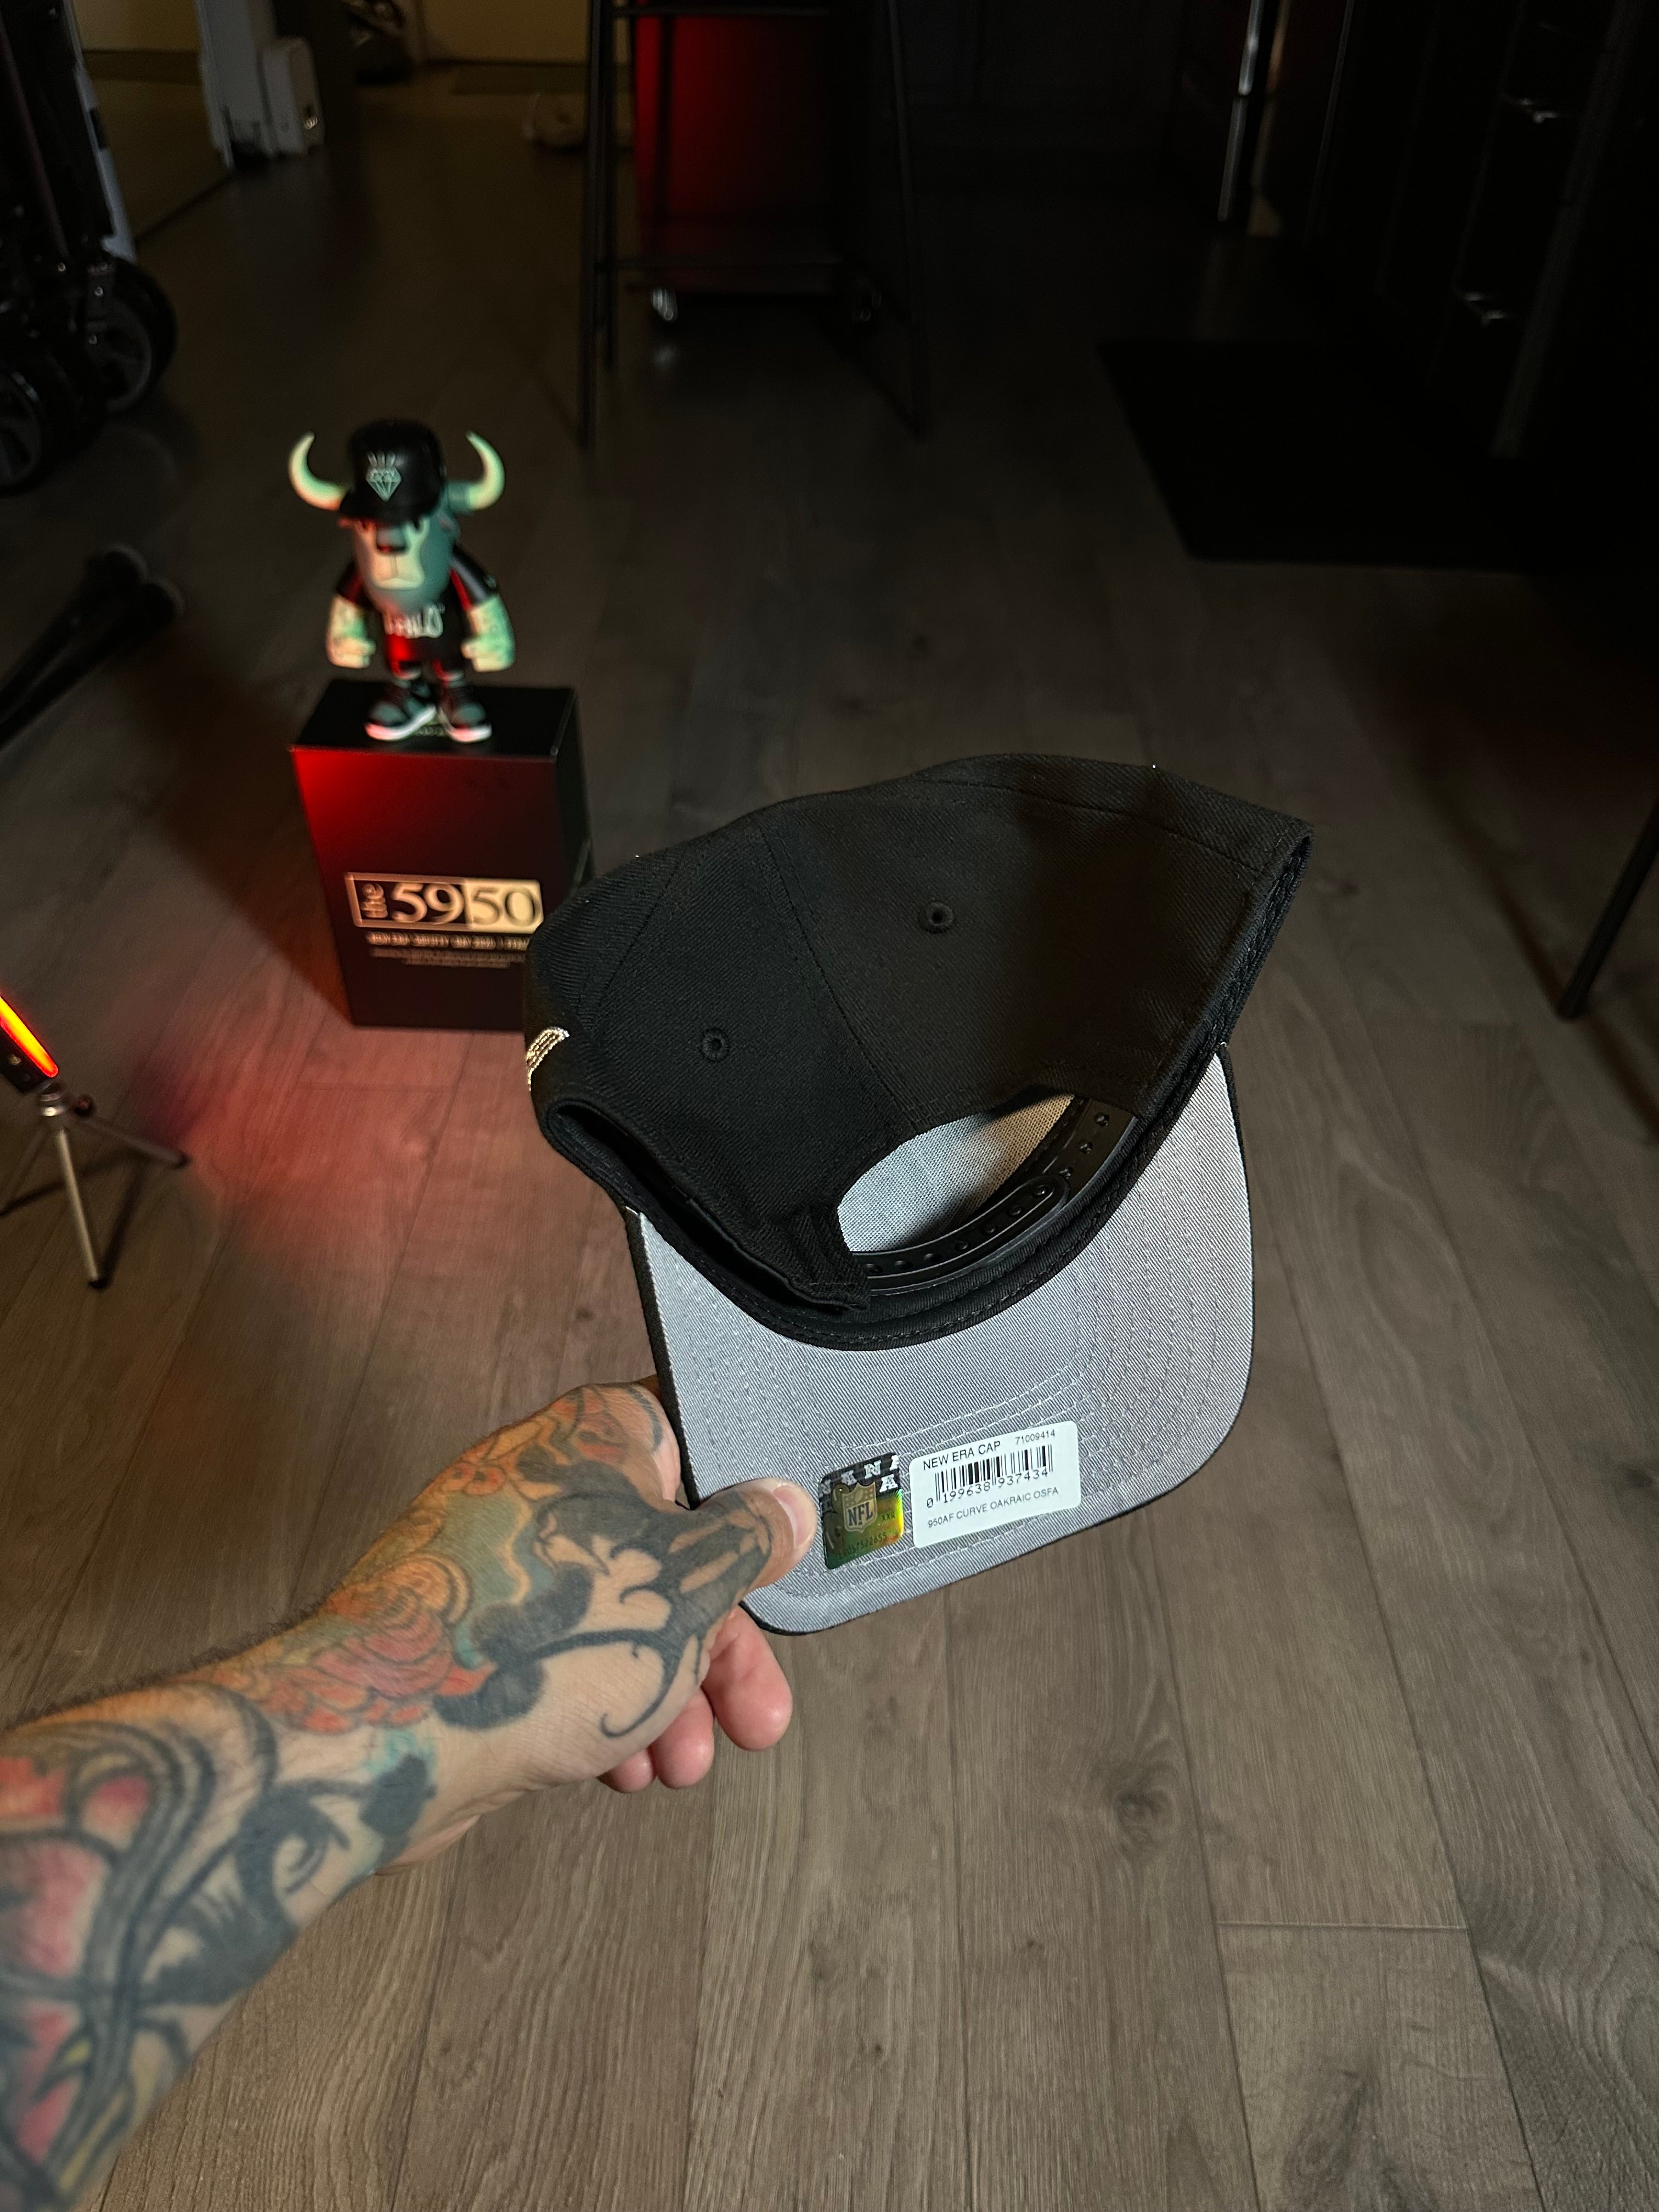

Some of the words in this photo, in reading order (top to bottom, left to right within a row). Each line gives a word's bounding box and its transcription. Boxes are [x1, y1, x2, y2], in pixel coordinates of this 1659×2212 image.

[1015, 1429, 1056, 1445] 71009414
[923, 1454, 949, 1470] NEW
[952, 1447, 974, 1462] ERA
[978, 1440, 1001, 1455] CAP
[927, 1498, 933, 1508] 0
[943, 1481, 991, 1503] 199638
[998, 1467, 1048, 1488] 937434
[847, 1501, 873, 1526] NFL
[928, 1513, 955, 1528] 950AF
[956, 1503, 988, 1519] CURVE
[990, 1492, 1031, 1510] OAKRAIC
[1034, 1486, 1059, 1499] OSFA
